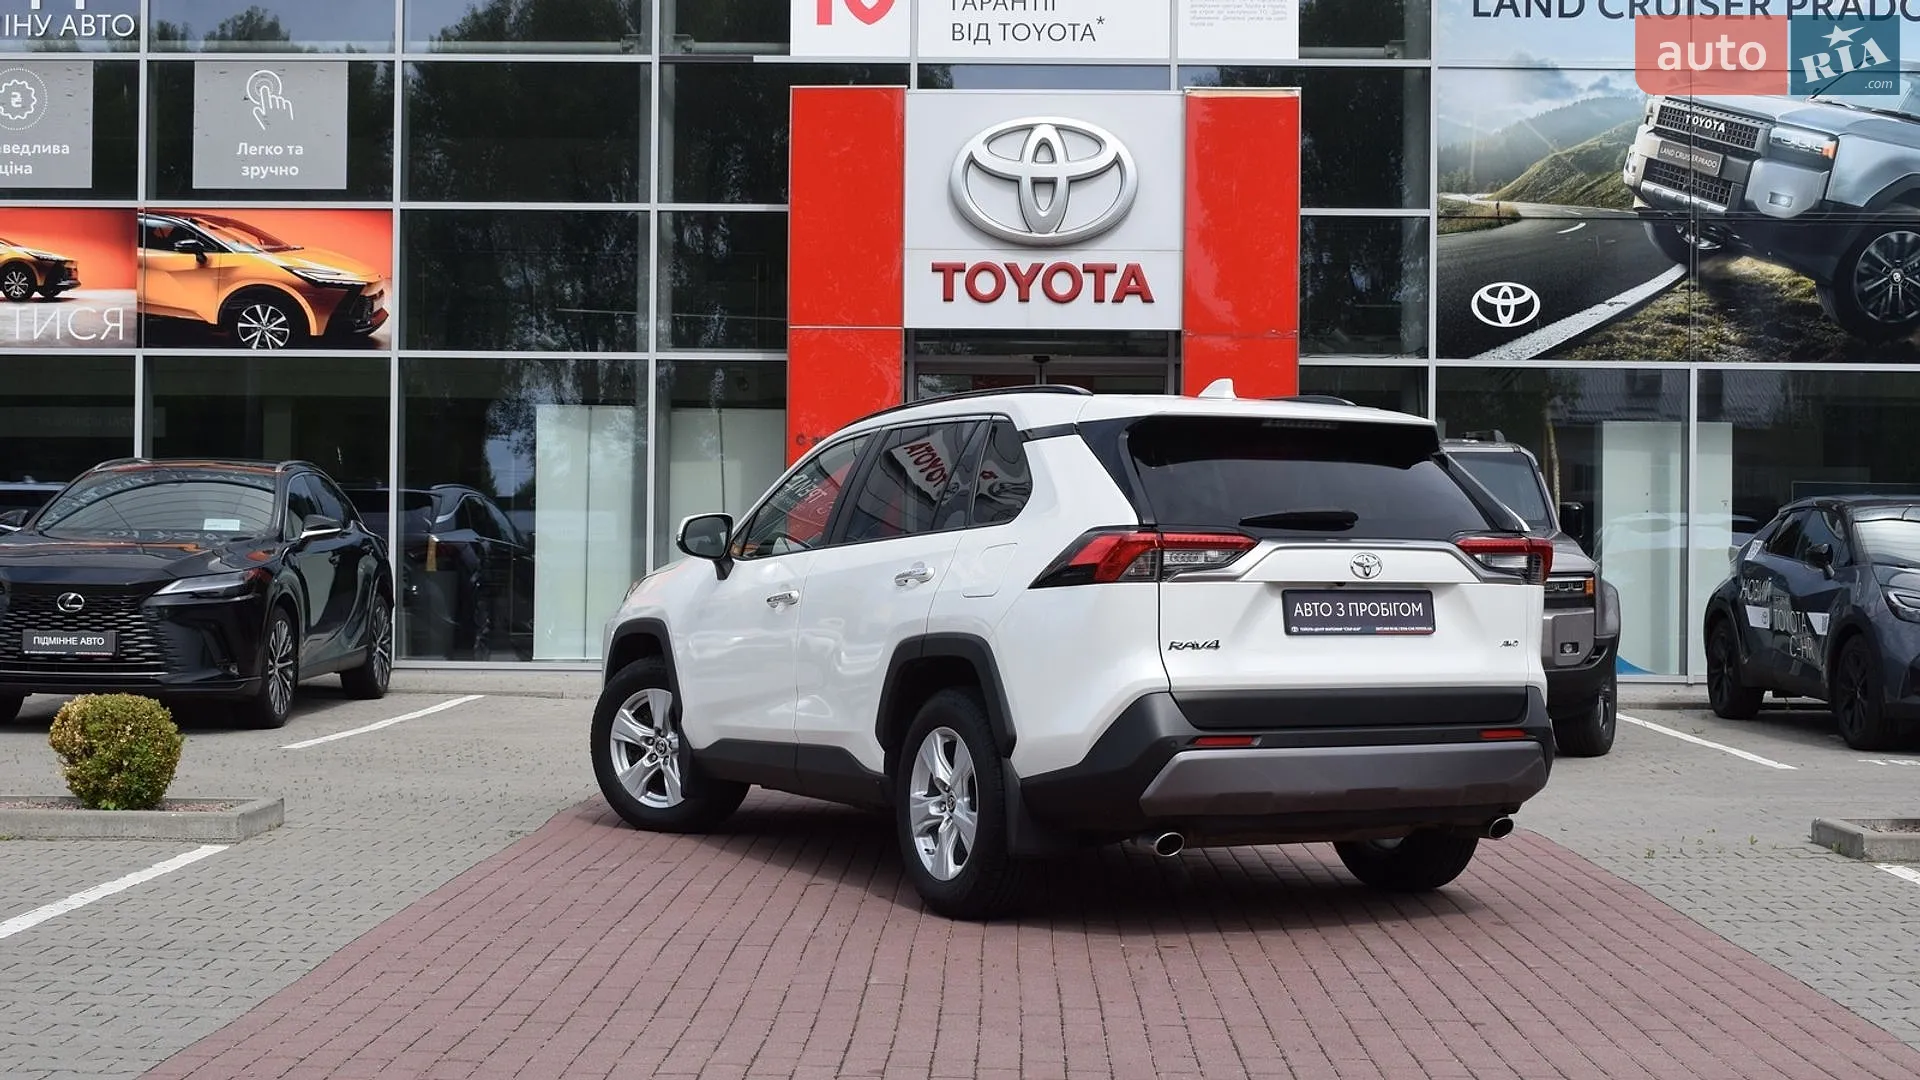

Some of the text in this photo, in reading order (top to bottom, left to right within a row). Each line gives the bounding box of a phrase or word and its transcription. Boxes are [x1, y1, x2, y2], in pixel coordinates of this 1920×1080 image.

[1472, 0, 1920, 22] LAND CRUISER PRADO
[60, 14, 135, 37] АВТО
[951, 23, 991, 45] ВІД
[1685, 115, 1726, 133] TOYOTA
[0, 144, 70, 155] ведлива
[236, 142, 304, 155] Легко та
[241, 166, 299, 179] зручно
[931, 262, 1155, 303] TOYOTA
[6, 306, 124, 340] ТИСЯ
[1293, 602, 1424, 617] АВТО З ПРОБІГОМ
[1773, 608, 1808, 634] TOYOTA
[33, 636, 105, 646] ПІДМІННЕ АВТО
[1168, 639, 1221, 651] RAV4
